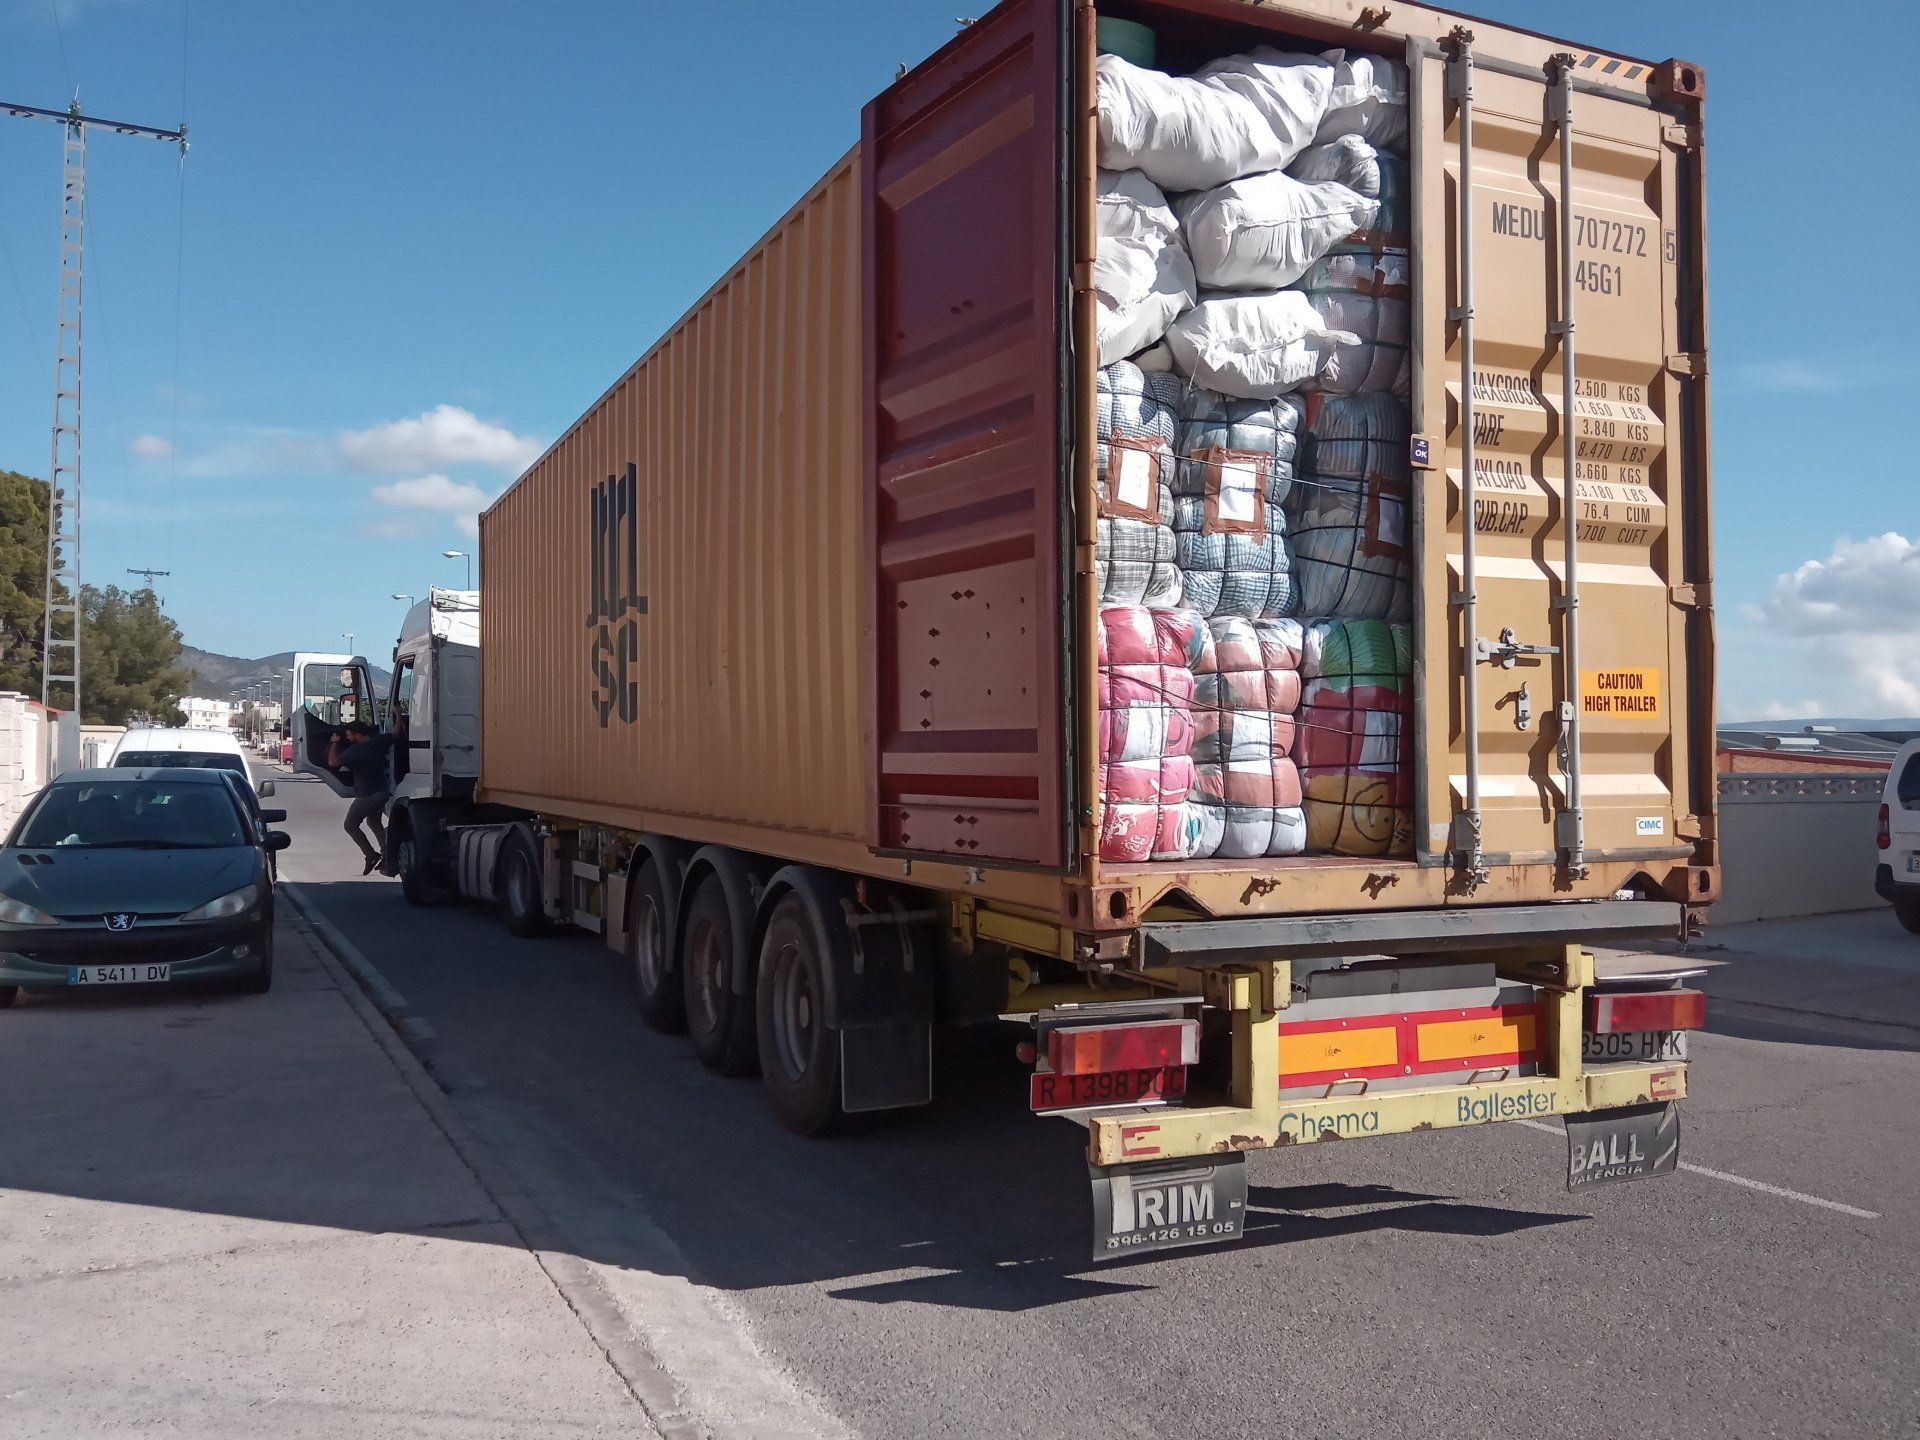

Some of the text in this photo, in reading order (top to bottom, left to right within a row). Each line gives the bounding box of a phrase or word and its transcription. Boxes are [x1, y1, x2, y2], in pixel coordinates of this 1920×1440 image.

[1492, 202, 1676, 262] MEDU 707272 5
[1575, 260, 1622, 296] 45G1
[1575, 379, 1607, 398] 2,500
[1619, 385, 1640, 403] KGS
[1622, 406, 1646, 421] LBS
[1473, 412, 1504, 446] TARE
[1627, 424, 1649, 441] KGS
[1415, 449, 1428, 459] OK
[1622, 446, 1647, 462] LBS
[1474, 459, 1527, 490] AYLOAD
[1620, 467, 1641, 484] KGS
[1623, 488, 1648, 502] LBS
[1474, 499, 1651, 534] CUB.CAP. 76.4 CUM
[1617, 528, 1648, 543] CUFT
[1597, 673, 1643, 690] CAUTION
[1584, 695, 1657, 712] HIGH TRAILER
[1638, 820, 1662, 829] CIMC
[78, 965, 168, 983] A 5411 DV
[1040, 1077, 1056, 1104] R
[1068, 1070, 1129, 1103] 1398
[1278, 1089, 1557, 1140] Chema Ballester
[1570, 1133, 1645, 1175] BALL
[1569, 1165, 1643, 1187] VALENCIA
[1186, 1224, 1207, 1237] 15
[1212, 1221, 1234, 1234] 05
